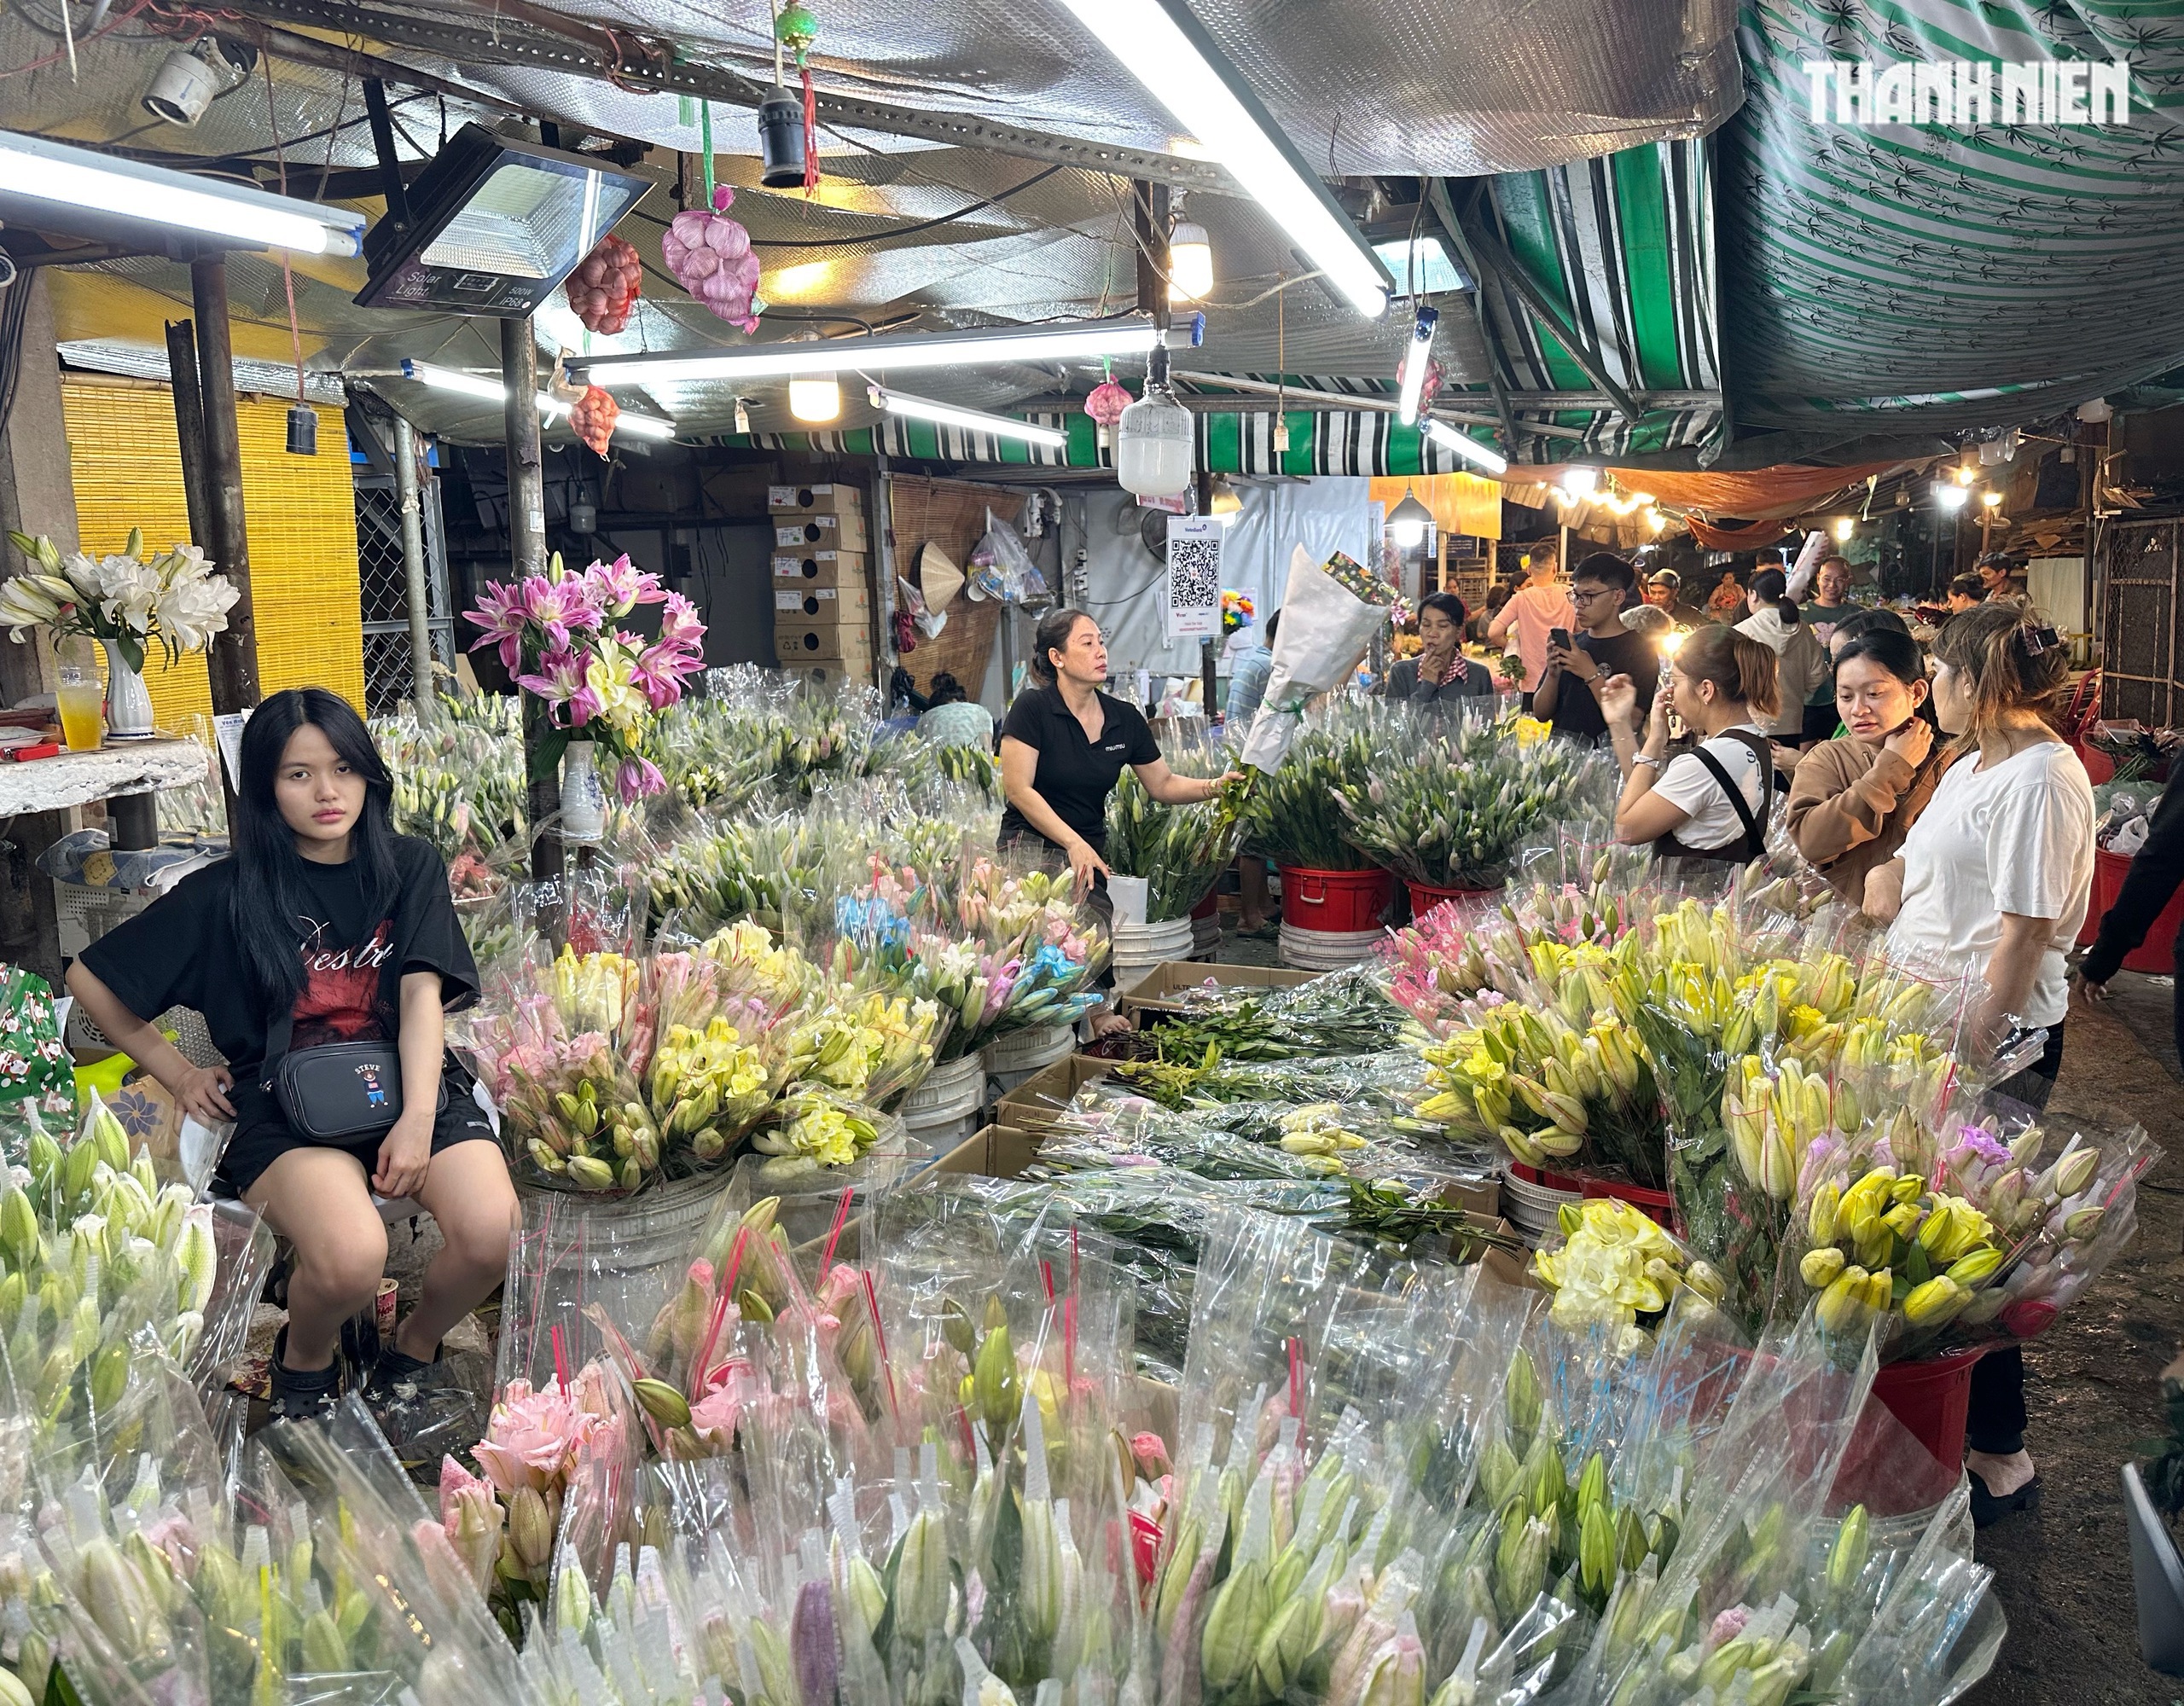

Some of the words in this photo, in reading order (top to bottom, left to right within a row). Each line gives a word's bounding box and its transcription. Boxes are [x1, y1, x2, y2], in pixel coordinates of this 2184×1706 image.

[407, 271, 442, 284] Solar
[395, 284, 429, 298] Light
[508, 287, 534, 296] 500W
[499, 297, 524, 307] IP68
[354, 1064, 381, 1075] STEVE
